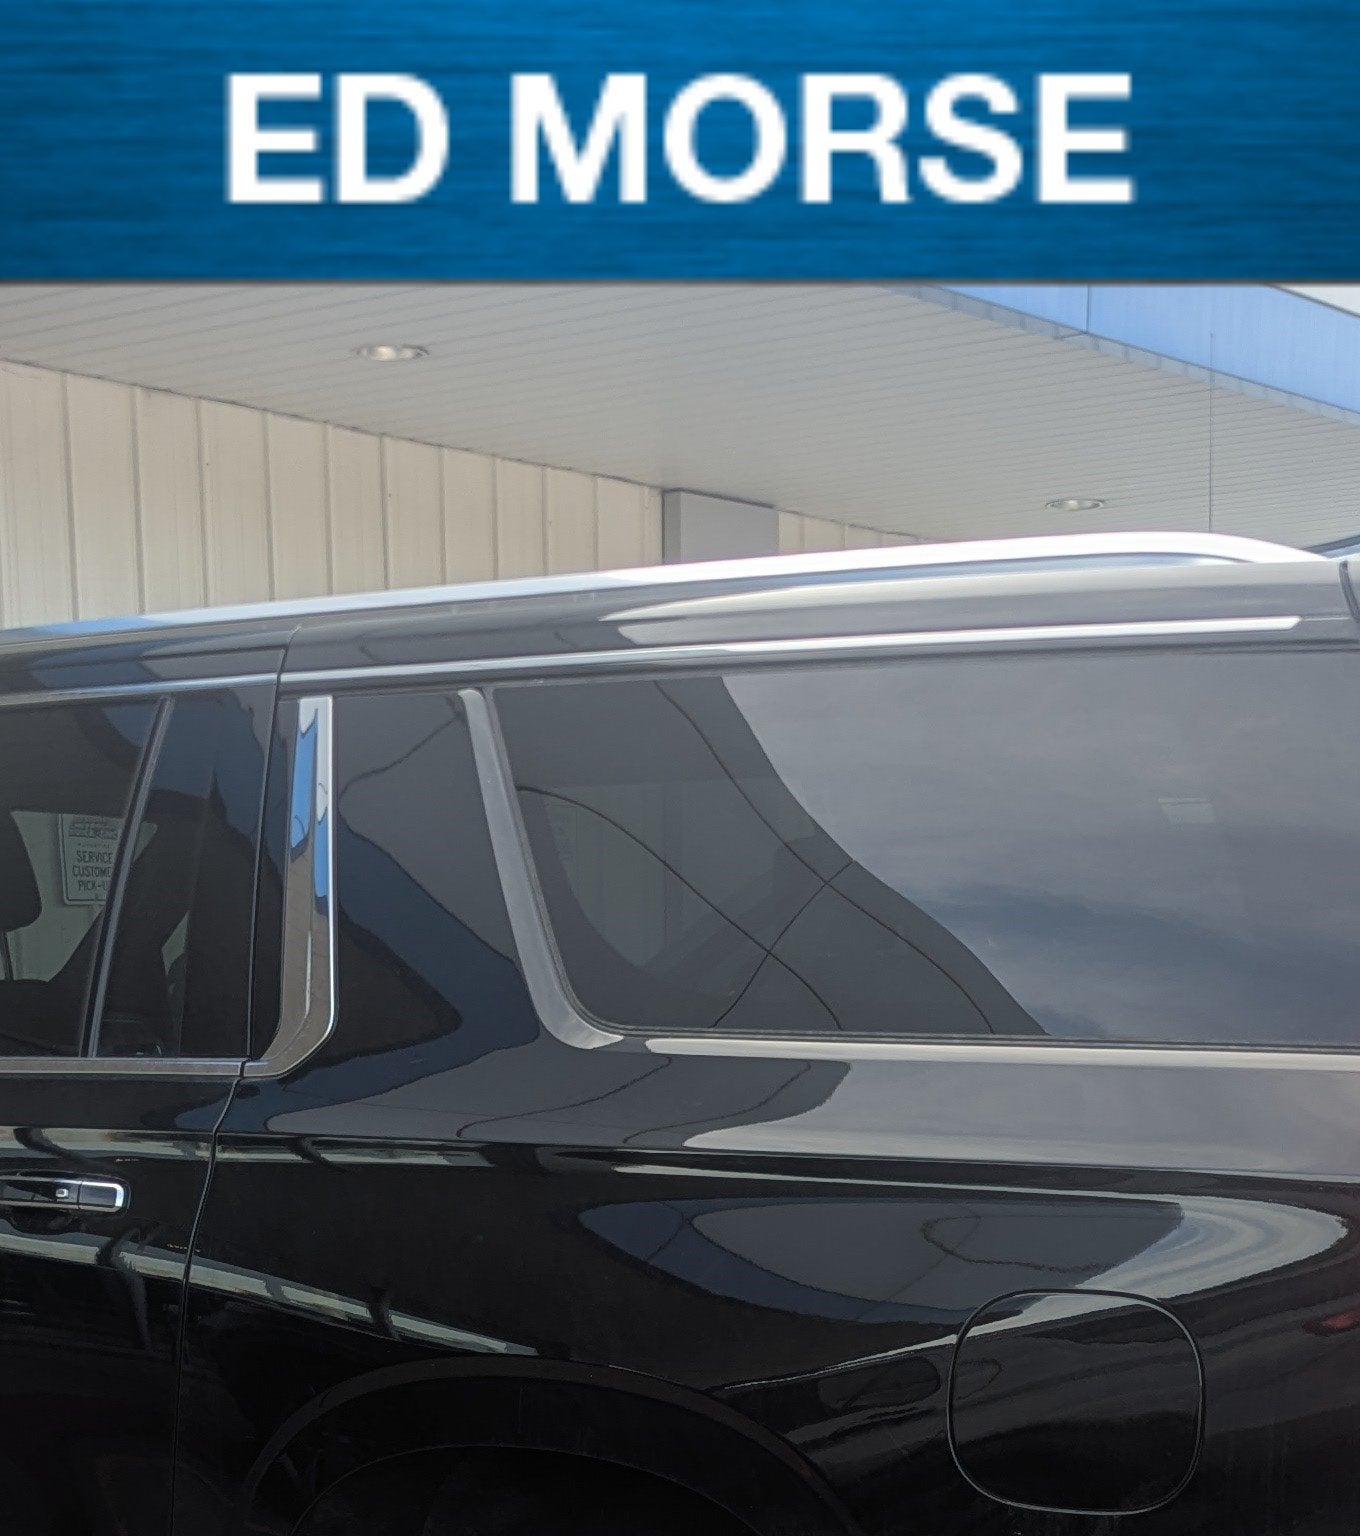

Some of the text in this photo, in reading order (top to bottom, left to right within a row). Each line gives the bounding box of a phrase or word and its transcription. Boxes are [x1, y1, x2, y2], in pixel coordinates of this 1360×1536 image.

[76, 850, 114, 863] SERVICE
[72, 865, 112, 878] CUSTOME
[78, 880, 107, 892] PICK-U
